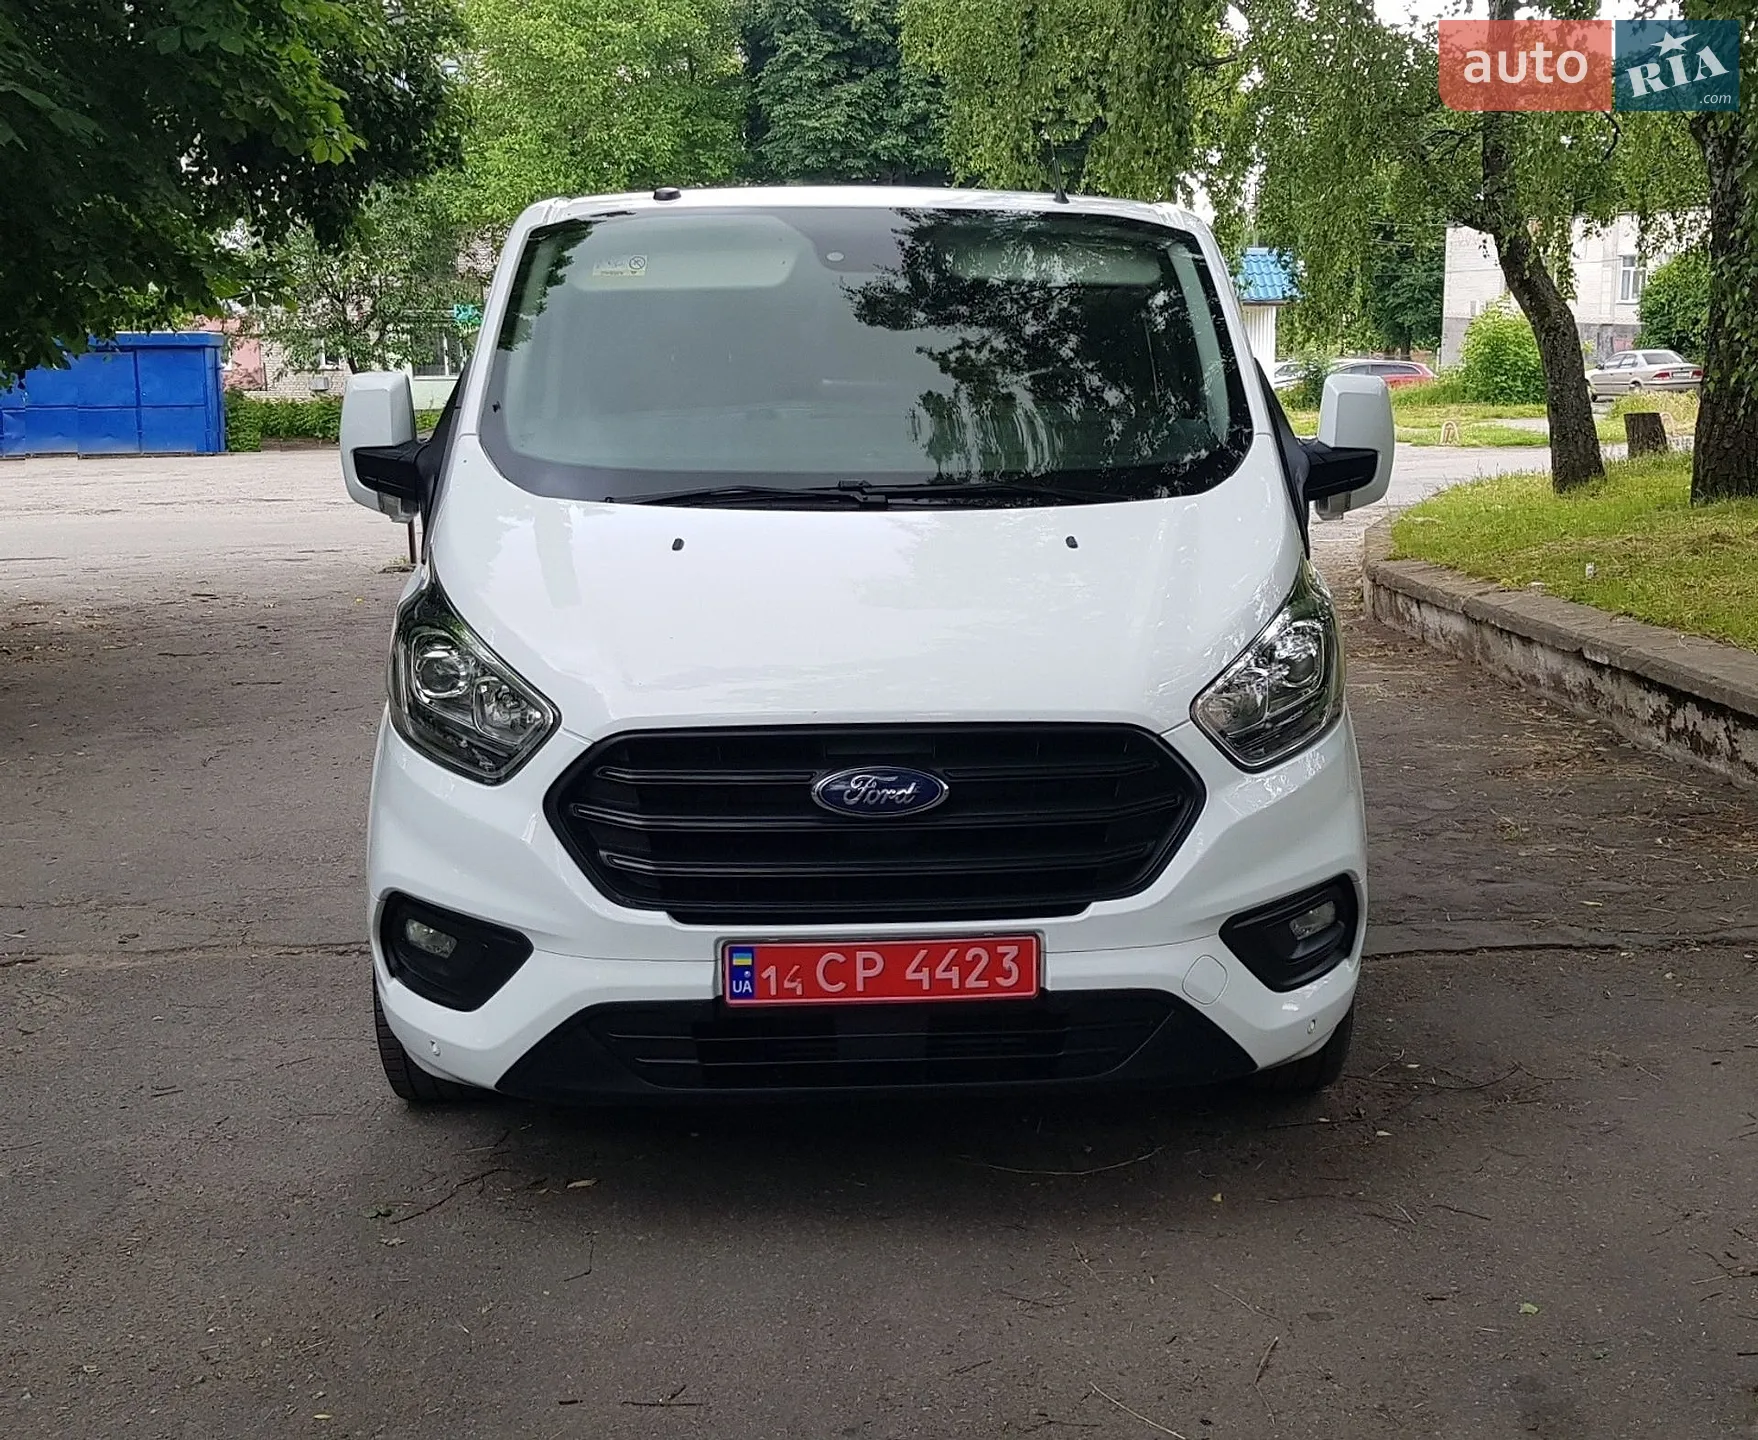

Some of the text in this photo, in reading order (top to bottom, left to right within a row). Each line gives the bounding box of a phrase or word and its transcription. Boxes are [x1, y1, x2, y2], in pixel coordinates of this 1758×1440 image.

[843, 774, 915, 805] Ford
[761, 945, 1019, 995] 14 CP 4423
[732, 980, 752, 993] UA
